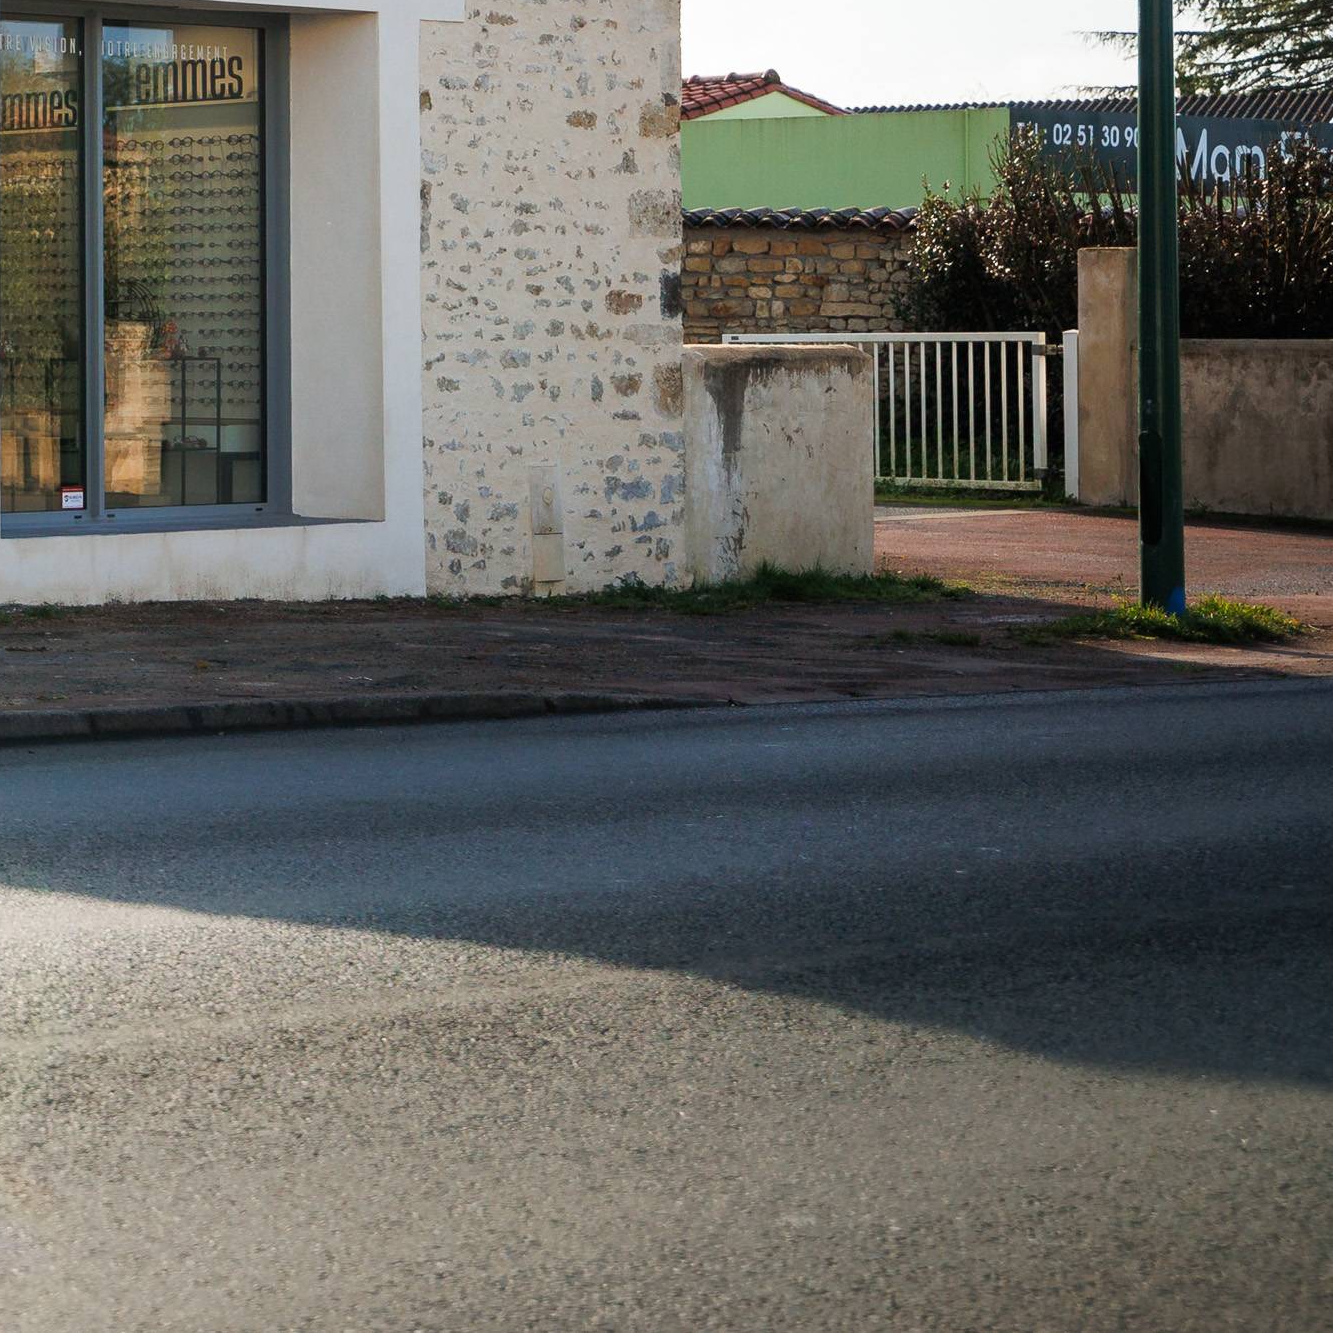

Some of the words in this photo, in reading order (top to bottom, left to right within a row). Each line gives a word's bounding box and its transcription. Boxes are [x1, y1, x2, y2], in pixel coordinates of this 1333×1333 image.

[29, 35, 82, 56] VISION,
[148, 42, 228, 61] ENGAGEMENT
[135, 56, 243, 101] emmes
[0, 89, 77, 128] mmes
[1053, 123, 1072, 145] 02
[1077, 125, 1093, 146] 51
[1101, 126, 1120, 147] 30
